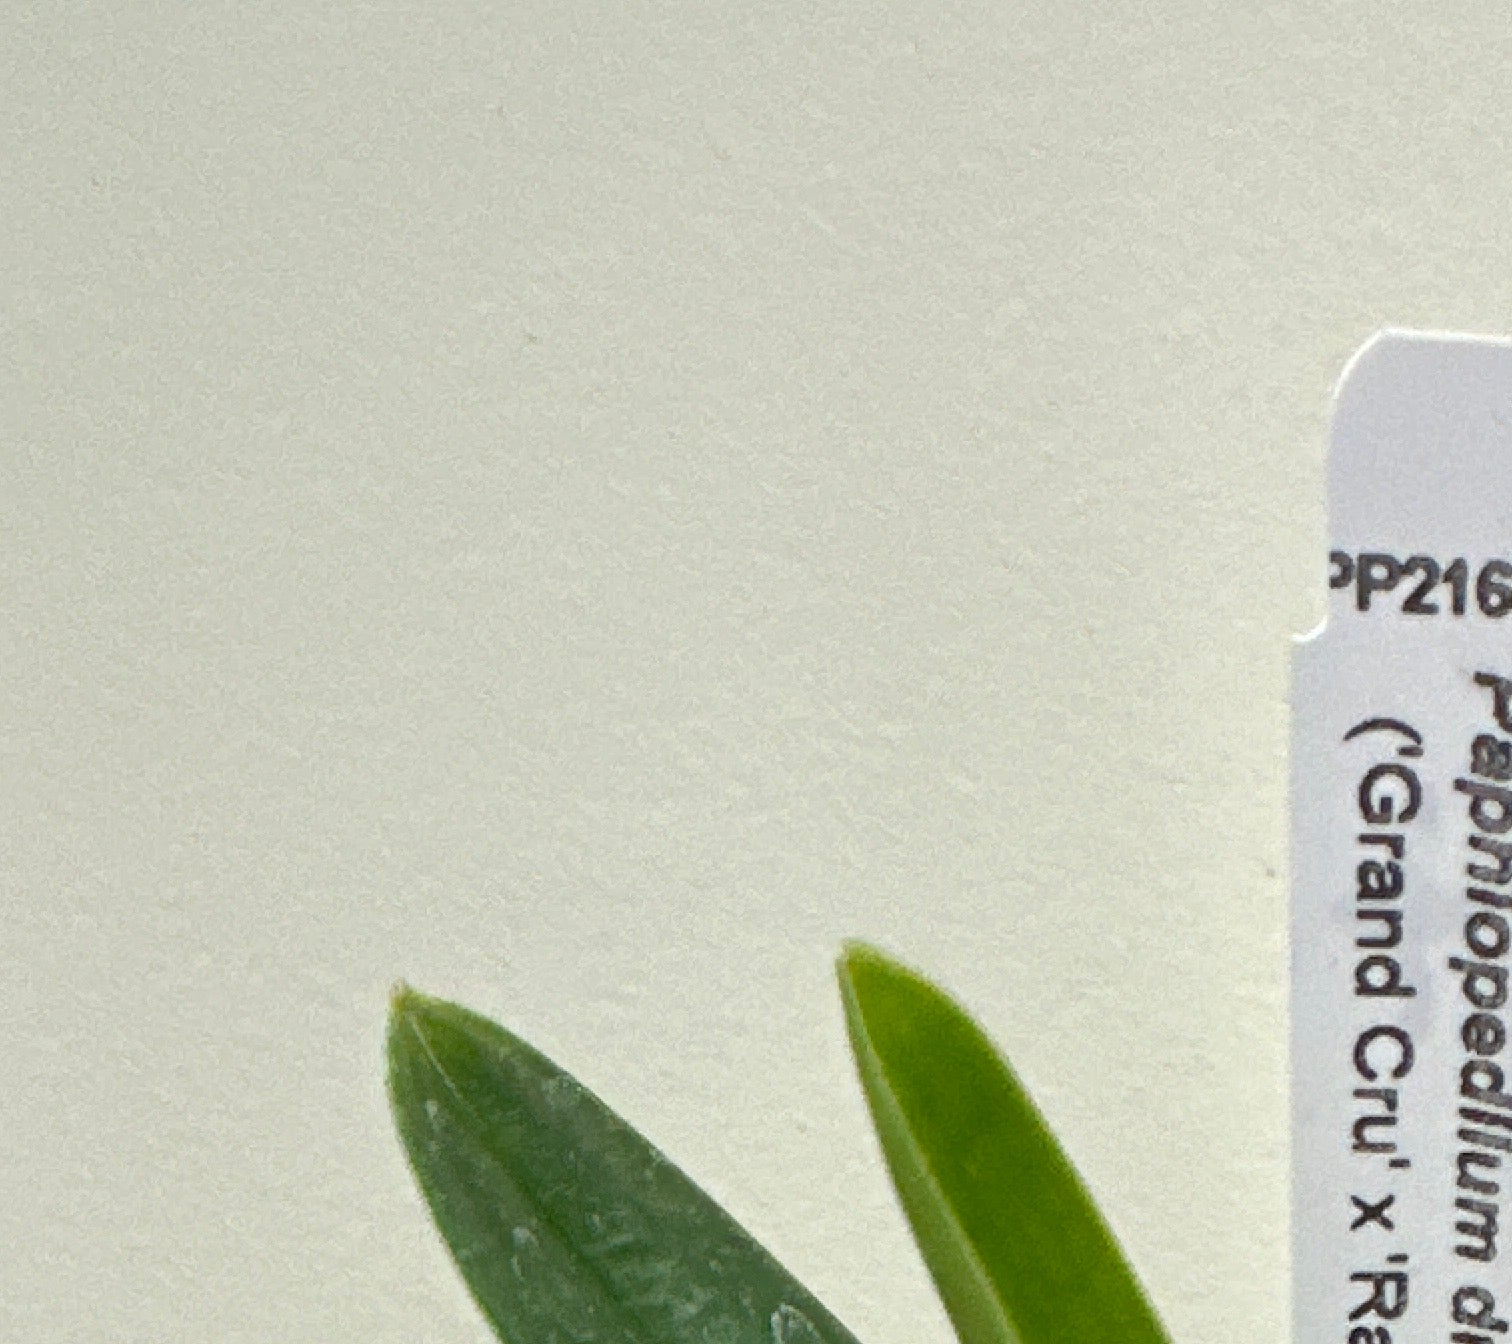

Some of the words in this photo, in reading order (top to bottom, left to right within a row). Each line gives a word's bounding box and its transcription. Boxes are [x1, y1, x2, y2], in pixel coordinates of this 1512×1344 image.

[1343, 717, 1424, 998] ('Grand
[1351, 1024, 1415, 1169] Cru'
[1350, 1194, 1396, 1231] x
